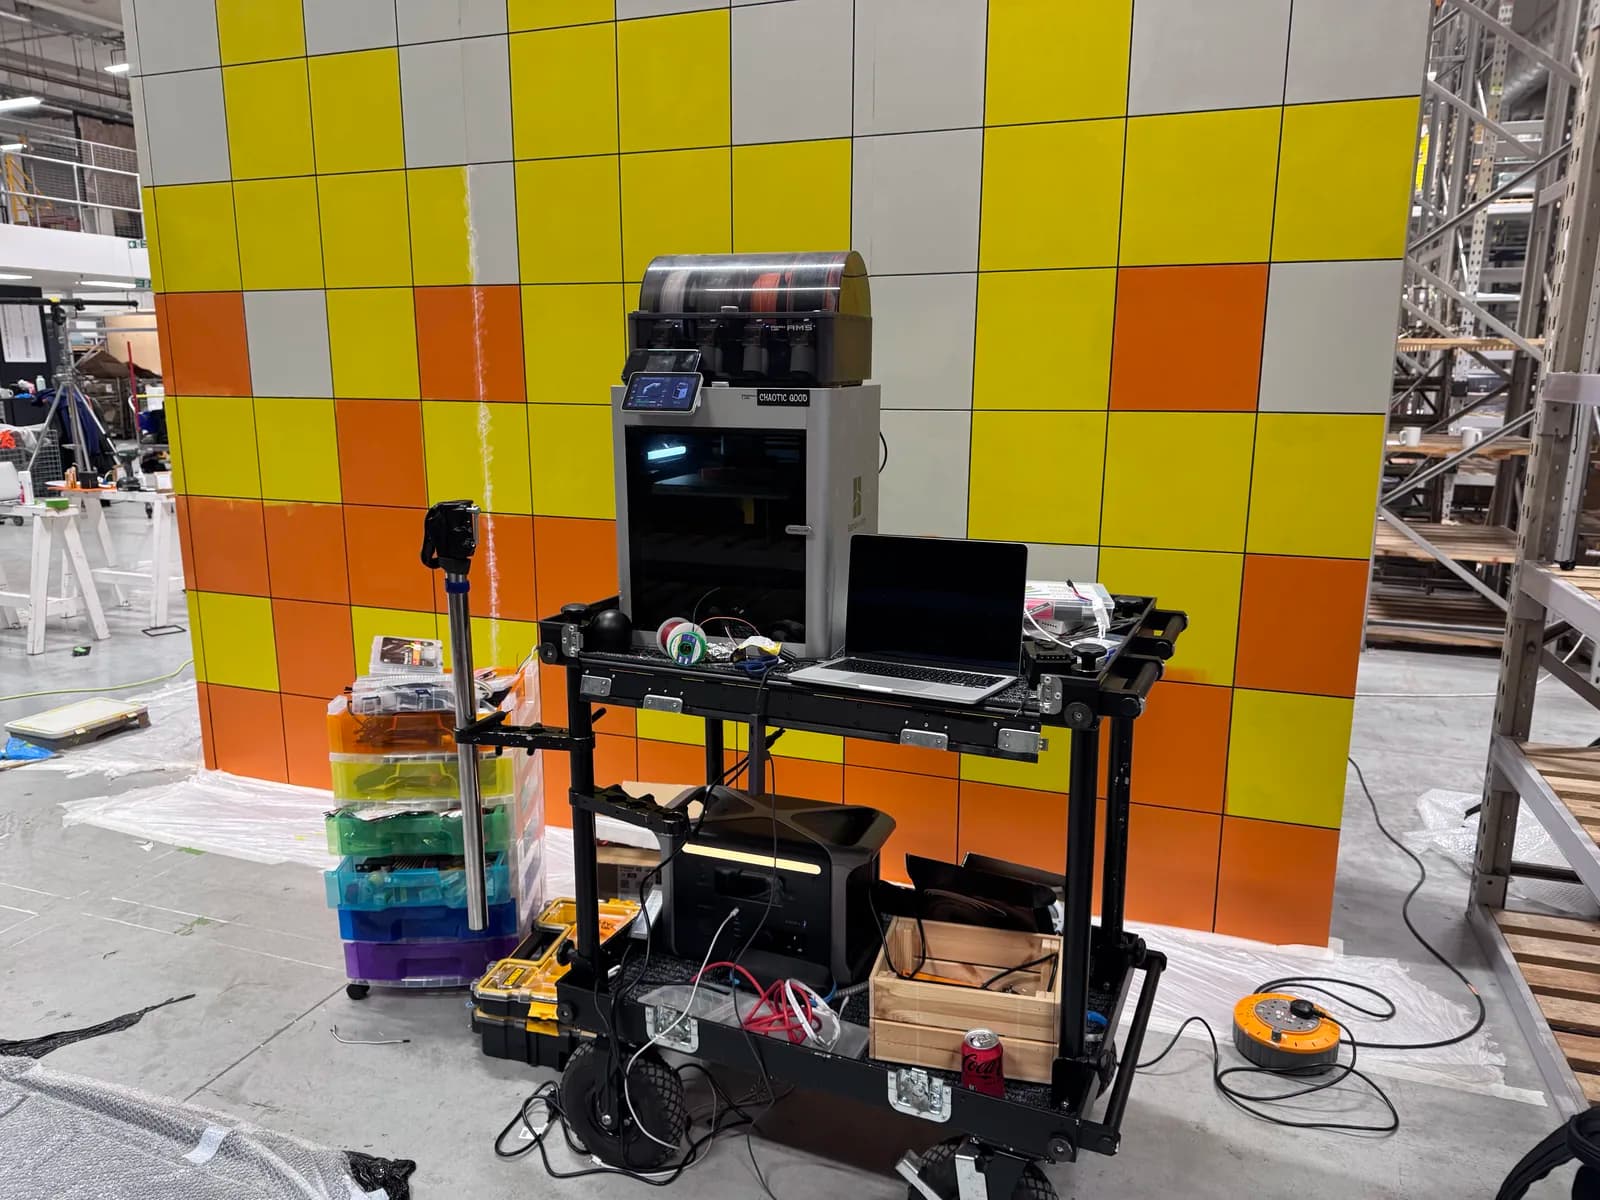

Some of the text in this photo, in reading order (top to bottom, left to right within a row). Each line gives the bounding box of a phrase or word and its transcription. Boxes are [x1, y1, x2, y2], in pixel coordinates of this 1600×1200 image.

[786, 324, 813, 332] AMS
[759, 393, 788, 402] CHAOTIC
[789, 393, 808, 402] GOOD
